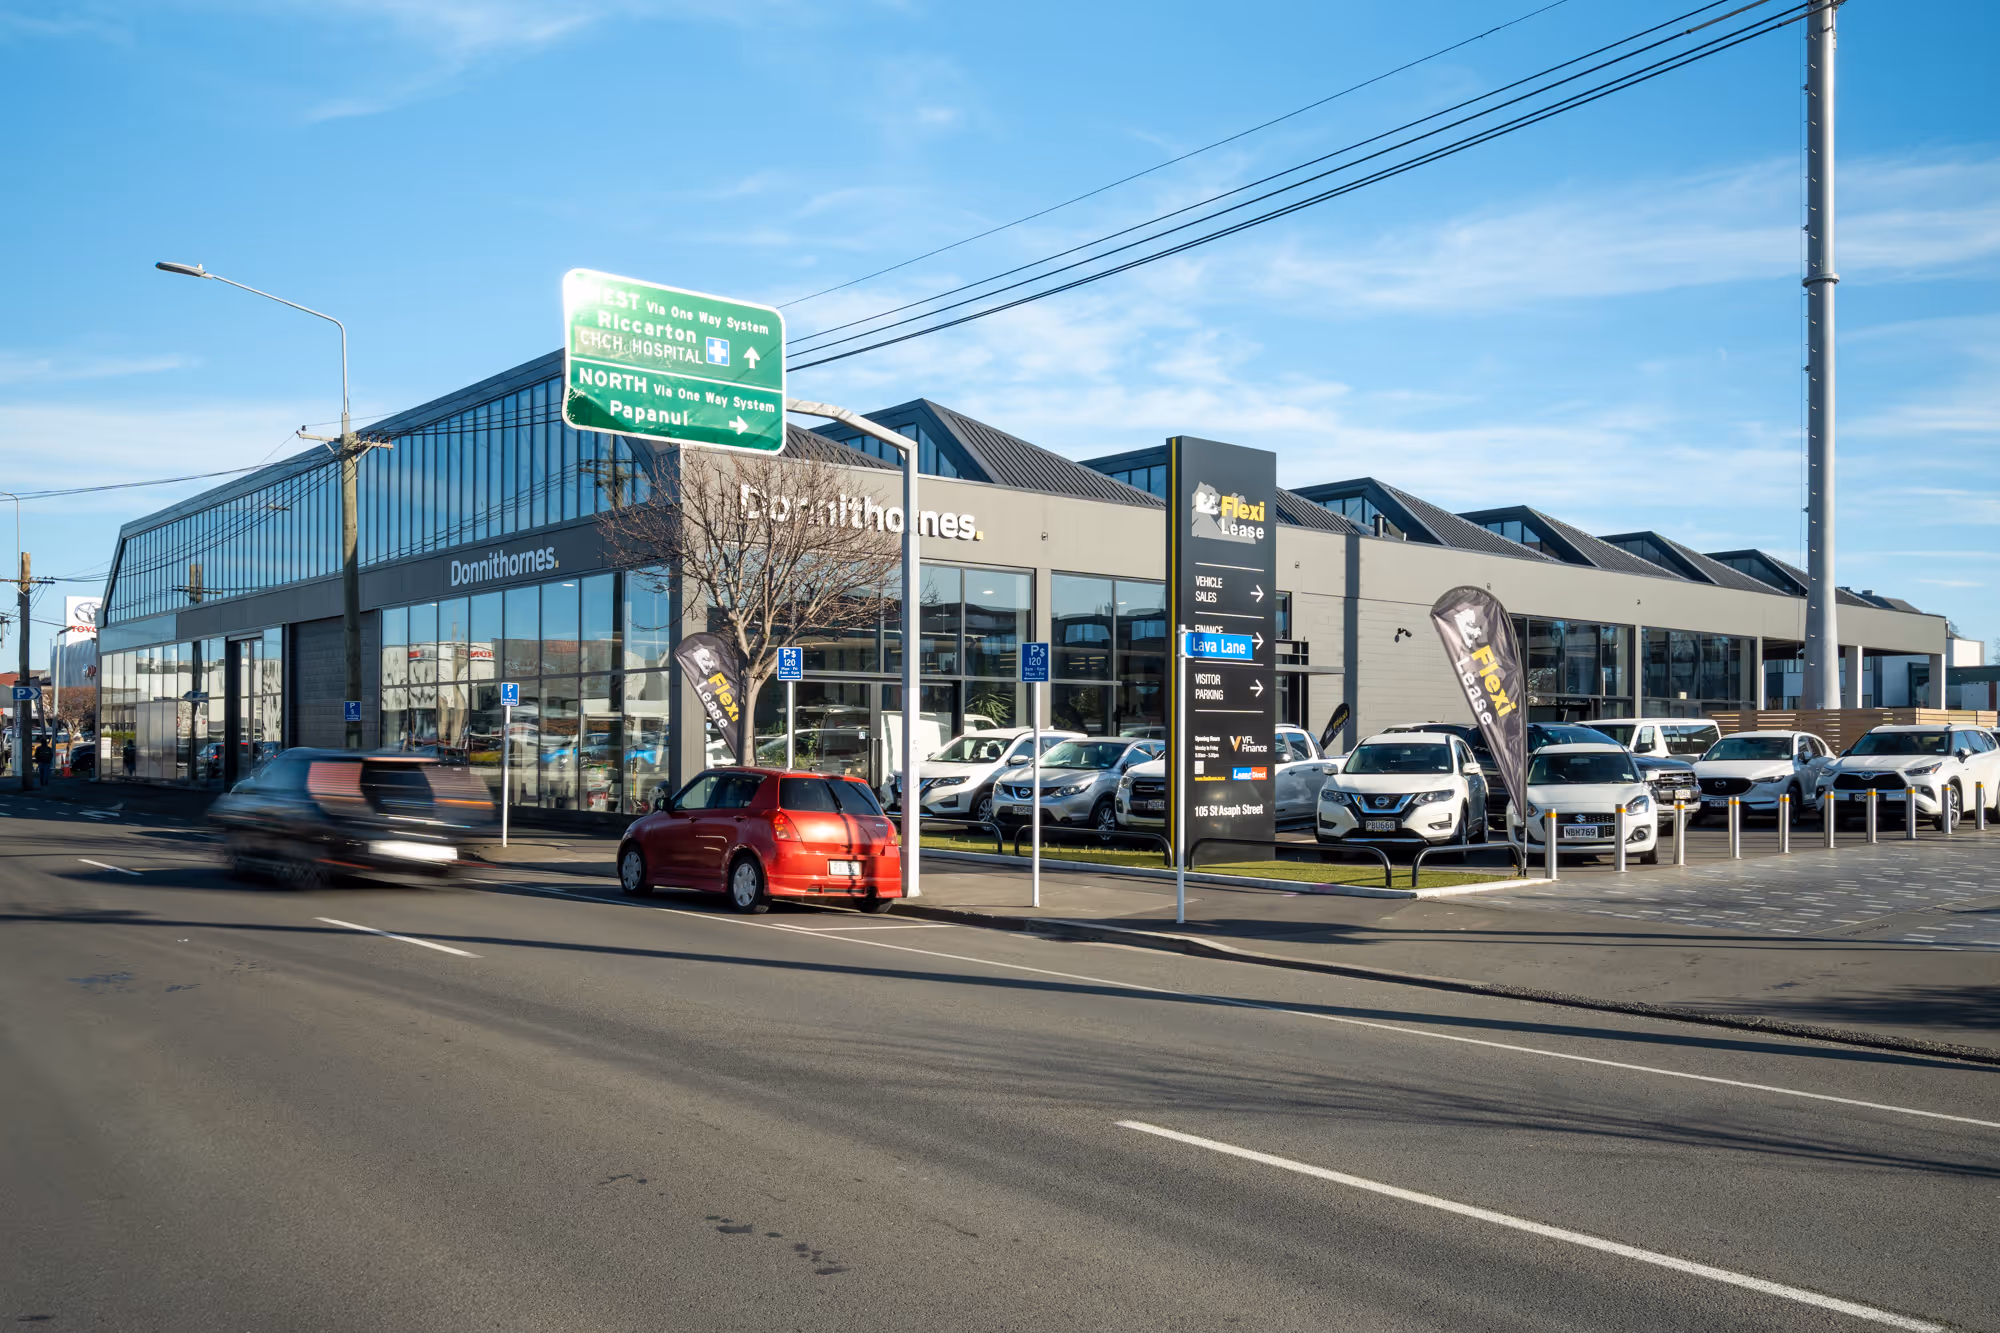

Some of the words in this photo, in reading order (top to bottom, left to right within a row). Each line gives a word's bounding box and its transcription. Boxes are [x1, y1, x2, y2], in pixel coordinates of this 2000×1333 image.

[594, 288, 640, 310] EST
[646, 301, 665, 316] Via
[671, 306, 693, 321] One
[699, 311, 721, 328] Way
[727, 317, 769, 335] System
[598, 310, 696, 344] Riccarton
[580, 331, 623, 351] CHCH
[632, 339, 703, 365] HOSPITAL
[579, 367, 647, 393] NORTH
[653, 384, 672, 398] Via
[678, 387, 700, 401] One
[705, 391, 728, 408] Way
[733, 397, 775, 413] System
[609, 400, 688, 426] Papanui
[740, 484, 984, 541] Donnithones.
[1221, 495, 1265, 522] Flexi
[1221, 518, 1264, 539] Lease
[451, 547, 560, 587] Donnithornes.
[1195, 575, 1222, 589] VEHICLE
[1195, 591, 1217, 604] SALES
[1192, 636, 1217, 653] Lava
[1221, 639, 1246, 655] Lane
[784, 659, 796, 667] 120
[1029, 657, 1042, 666] 120
[1195, 673, 1221, 685] VISITOR
[1471, 645, 1517, 718] Flexi
[17, 688, 26, 699] P
[1195, 689, 1224, 700] PARKING
[1456, 656, 1493, 725] Lease
[696, 681, 728, 728] Lease
[1242, 736, 1254, 744] VFL
[1242, 744, 1268, 752] Finance
[1195, 806, 1208, 817] 105
[1210, 805, 1218, 817] St
[1219, 805, 1240, 817] Asaph
[1242, 804, 1263, 815] Street
[1565, 828, 1596, 837] NBH769
